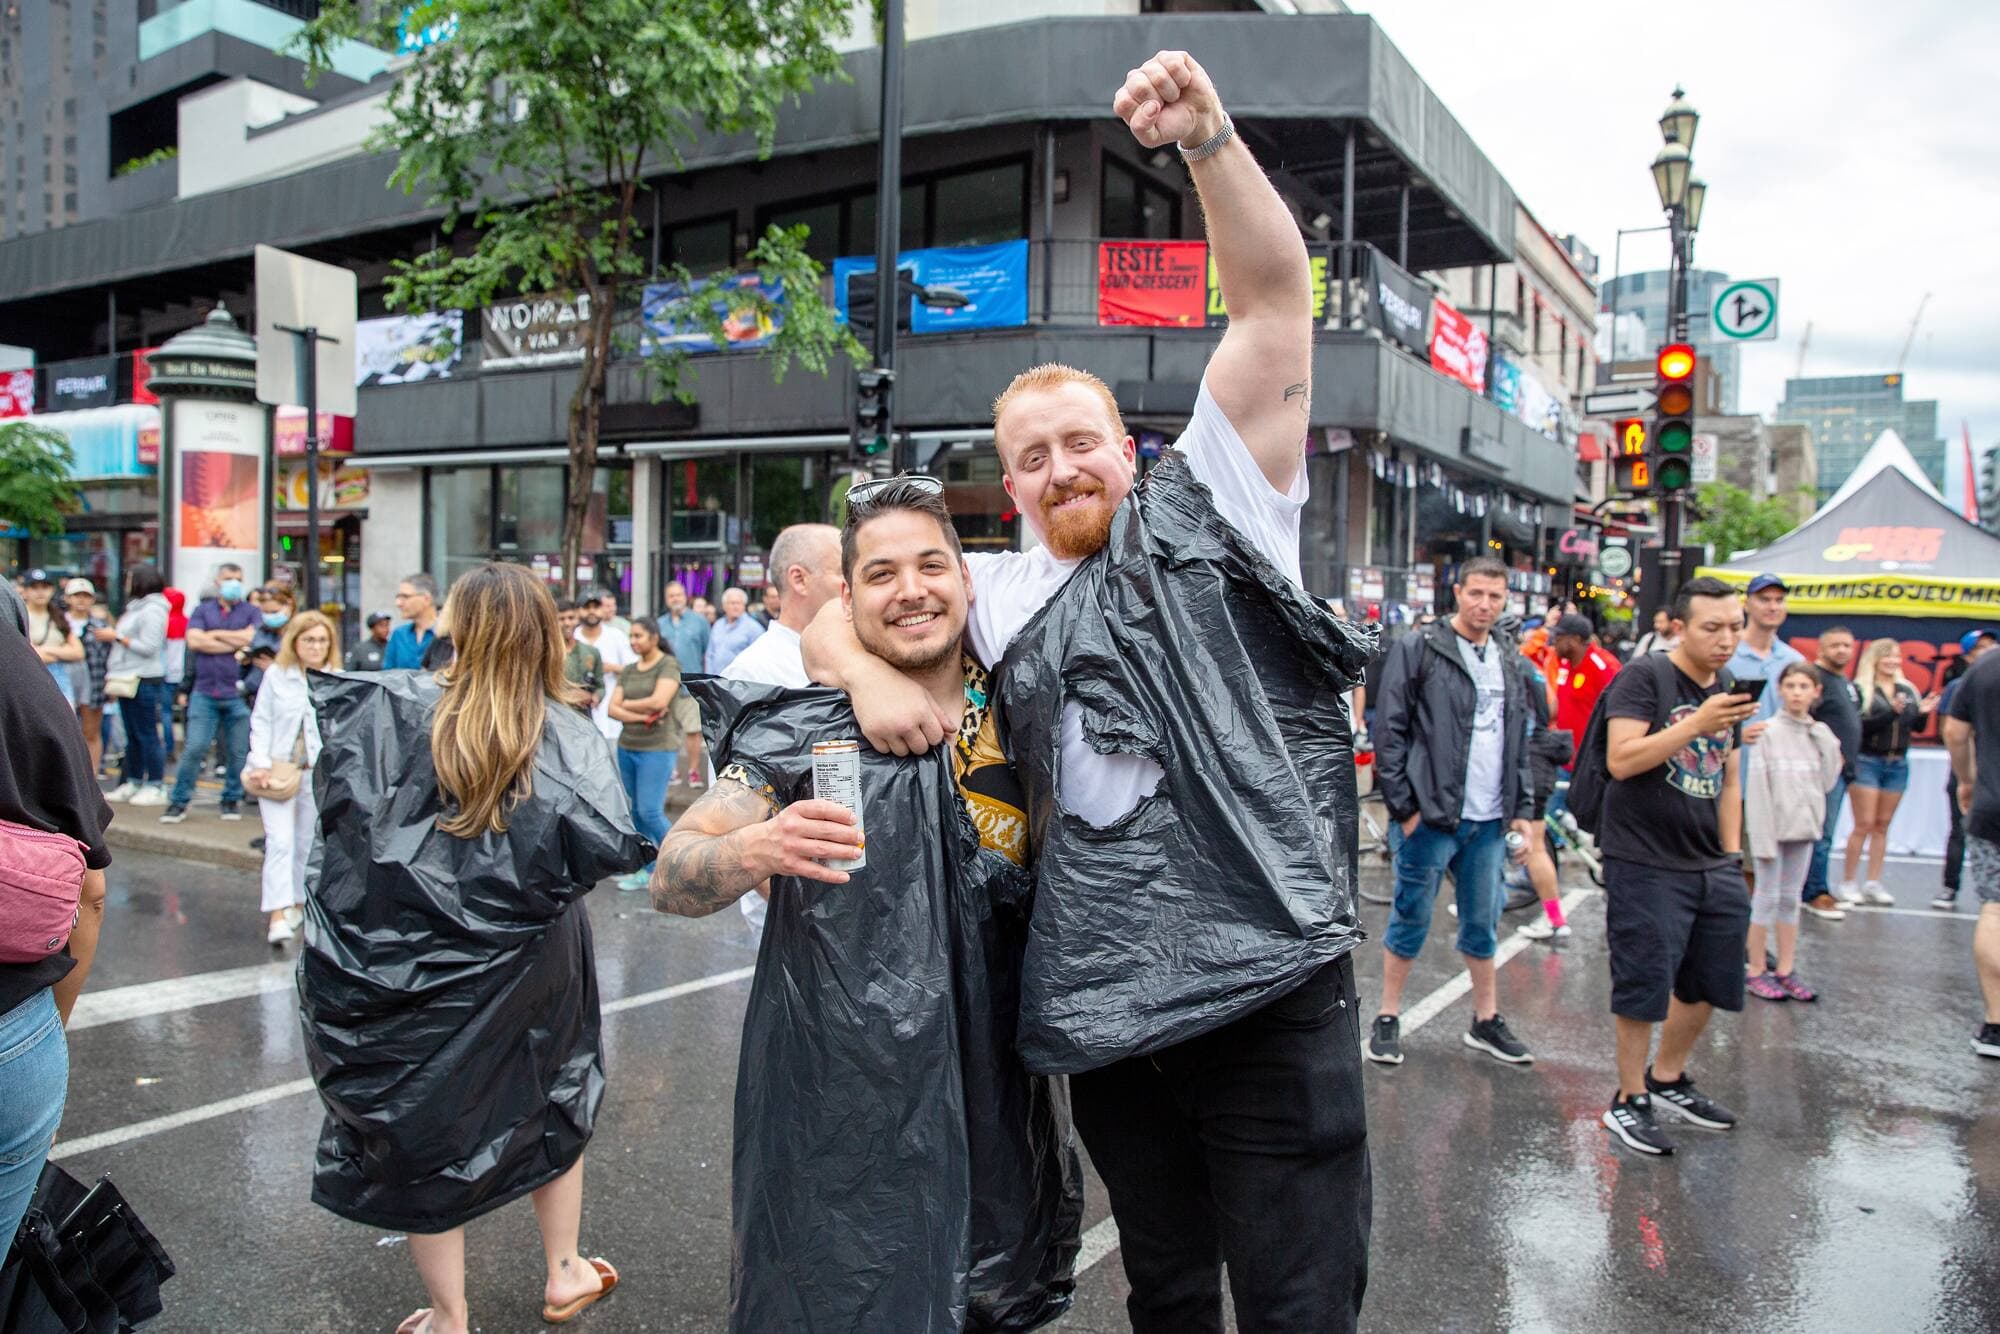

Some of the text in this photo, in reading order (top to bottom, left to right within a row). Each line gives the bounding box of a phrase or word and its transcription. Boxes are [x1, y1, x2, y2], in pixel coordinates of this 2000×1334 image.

[1105, 247, 1165, 271] TESTE
[1105, 274, 1199, 289] SUR CRESCENT
[528, 331, 560, 350] VAN
